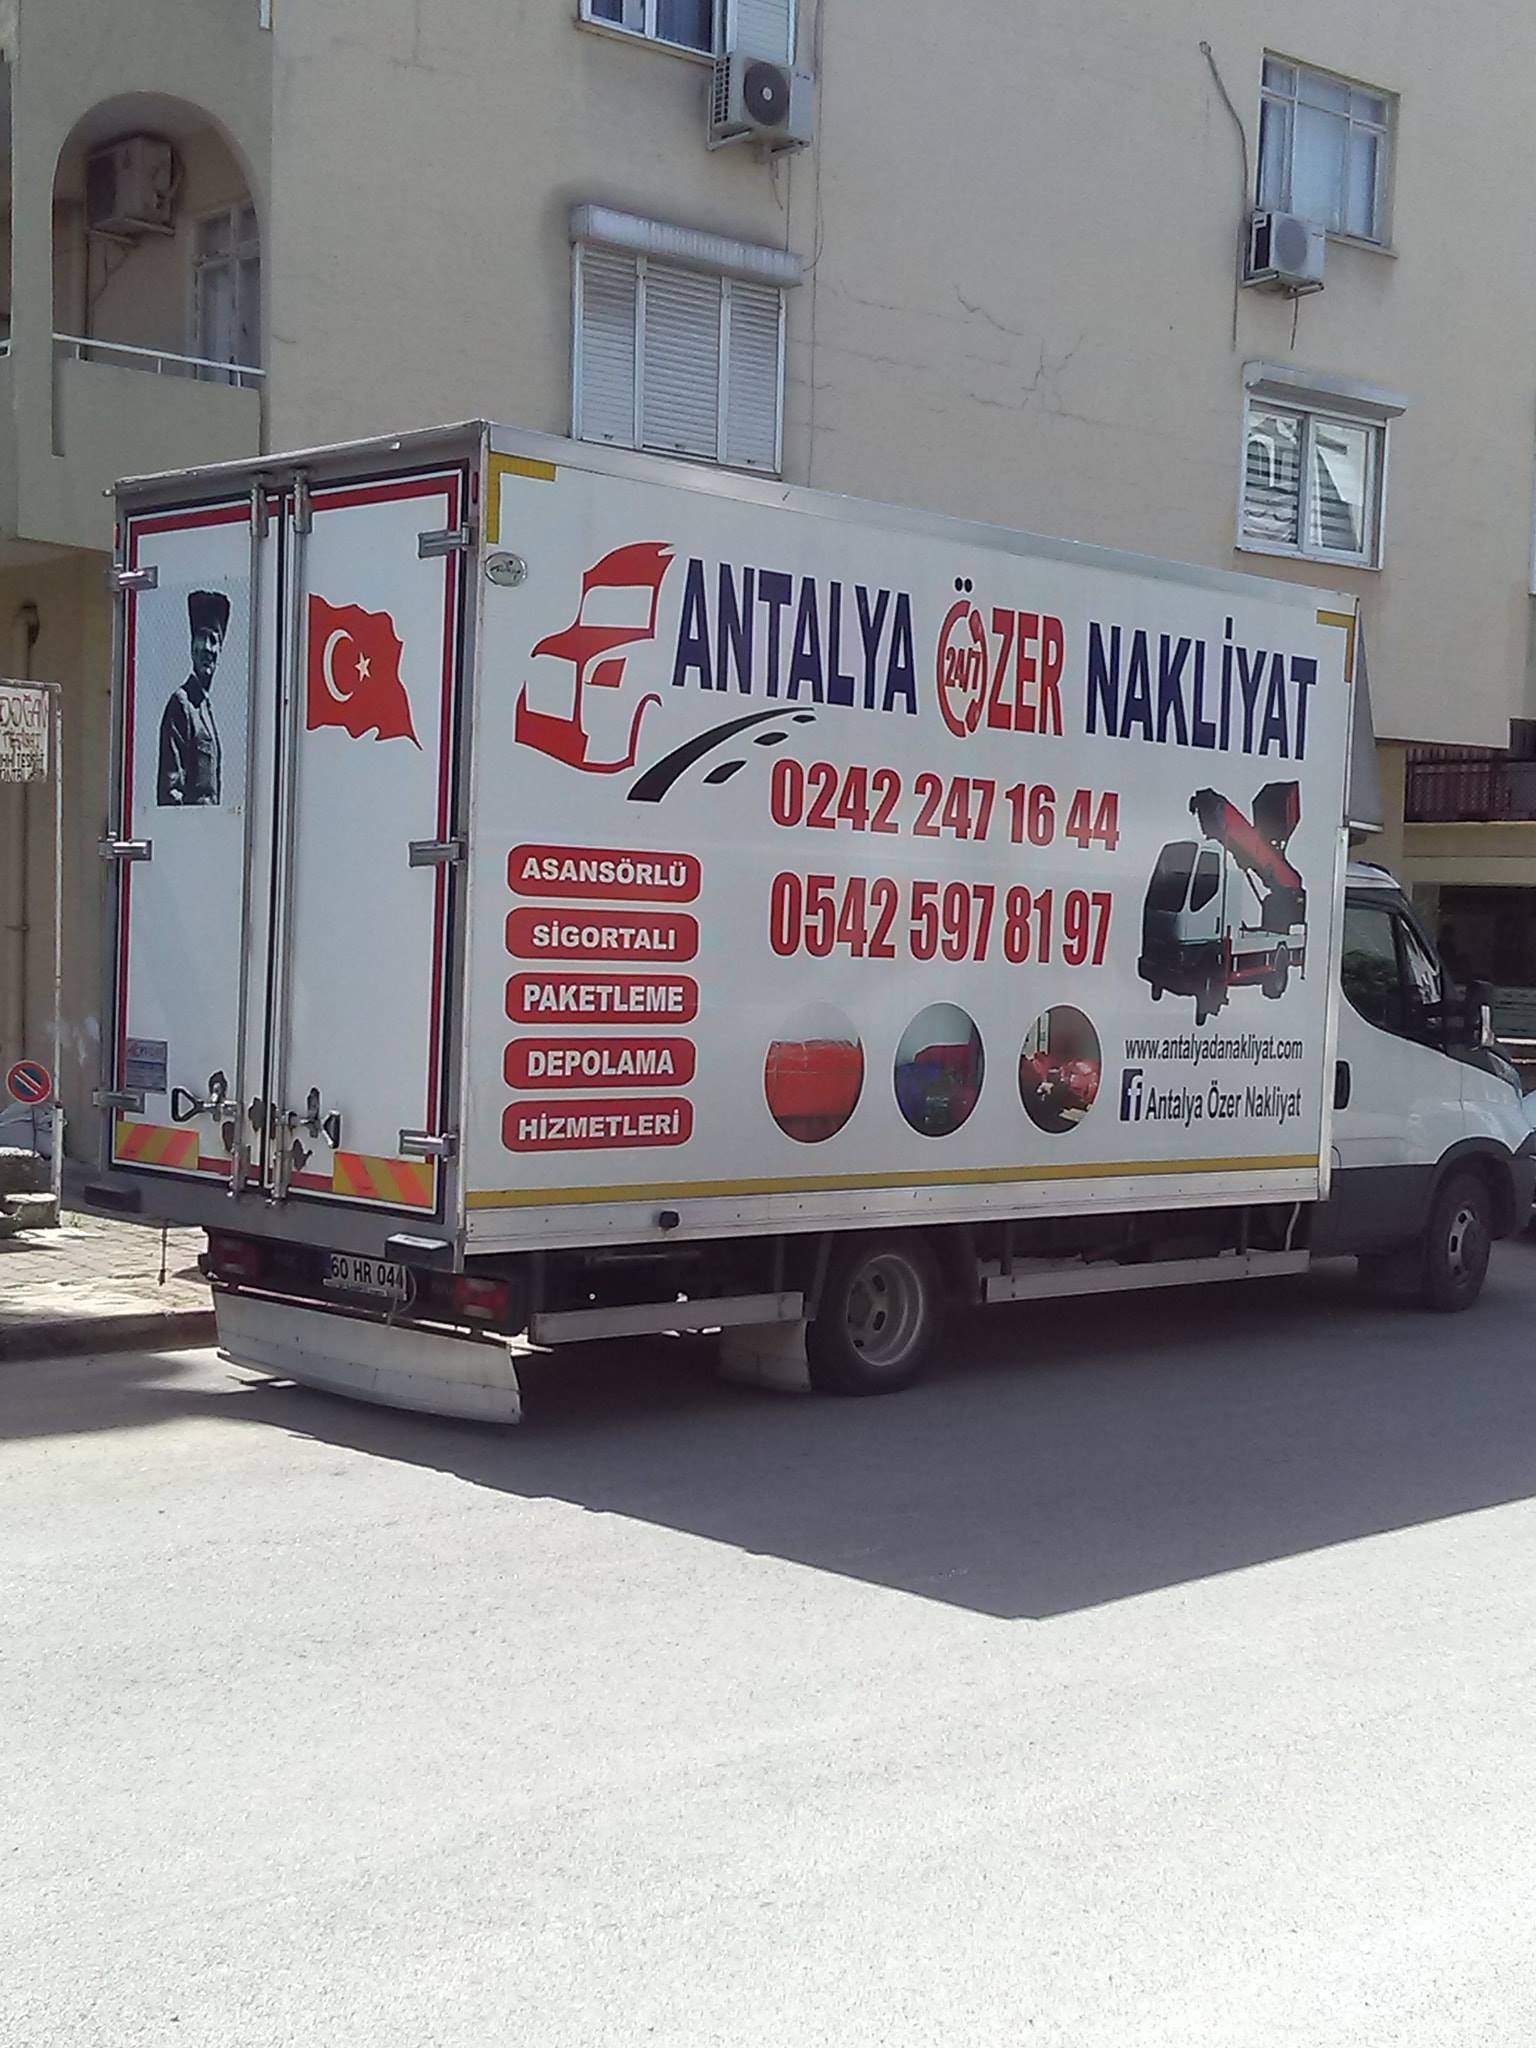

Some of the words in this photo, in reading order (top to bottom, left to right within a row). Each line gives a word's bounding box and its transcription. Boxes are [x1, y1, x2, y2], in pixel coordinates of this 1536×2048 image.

[672, 557, 918, 715] ANTALYA
[1085, 616, 1318, 760] NAKLİYAT
[945, 647, 981, 693] 24/7
[771, 759, 901, 833] 0242
[913, 773, 995, 840] 247
[1005, 783, 1056, 846] 16
[1065, 789, 1120, 851] 44
[521, 857, 687, 887] ASANSÖRLÜ
[533, 920, 676, 950] SİGORTALI
[770, 872, 898, 958] 0542
[910, 881, 995, 961] 597
[1004, 885, 1052, 964] 81
[1062, 890, 1112, 966] 97
[523, 983, 684, 1012] PAKETLEME
[528, 1049, 674, 1077] DEPOLAMA
[1125, 1033, 1303, 1066] www.antalyadanakliyat.com
[1145, 1087, 1202, 1128] Antalya
[1207, 1080, 1241, 1119] Özer
[1245, 1086, 1301, 1125] Nakliyat
[518, 1109, 680, 1140] HİZMETLERİ
[331, 1256, 349, 1279] 60
[353, 1260, 372, 1284] HR
